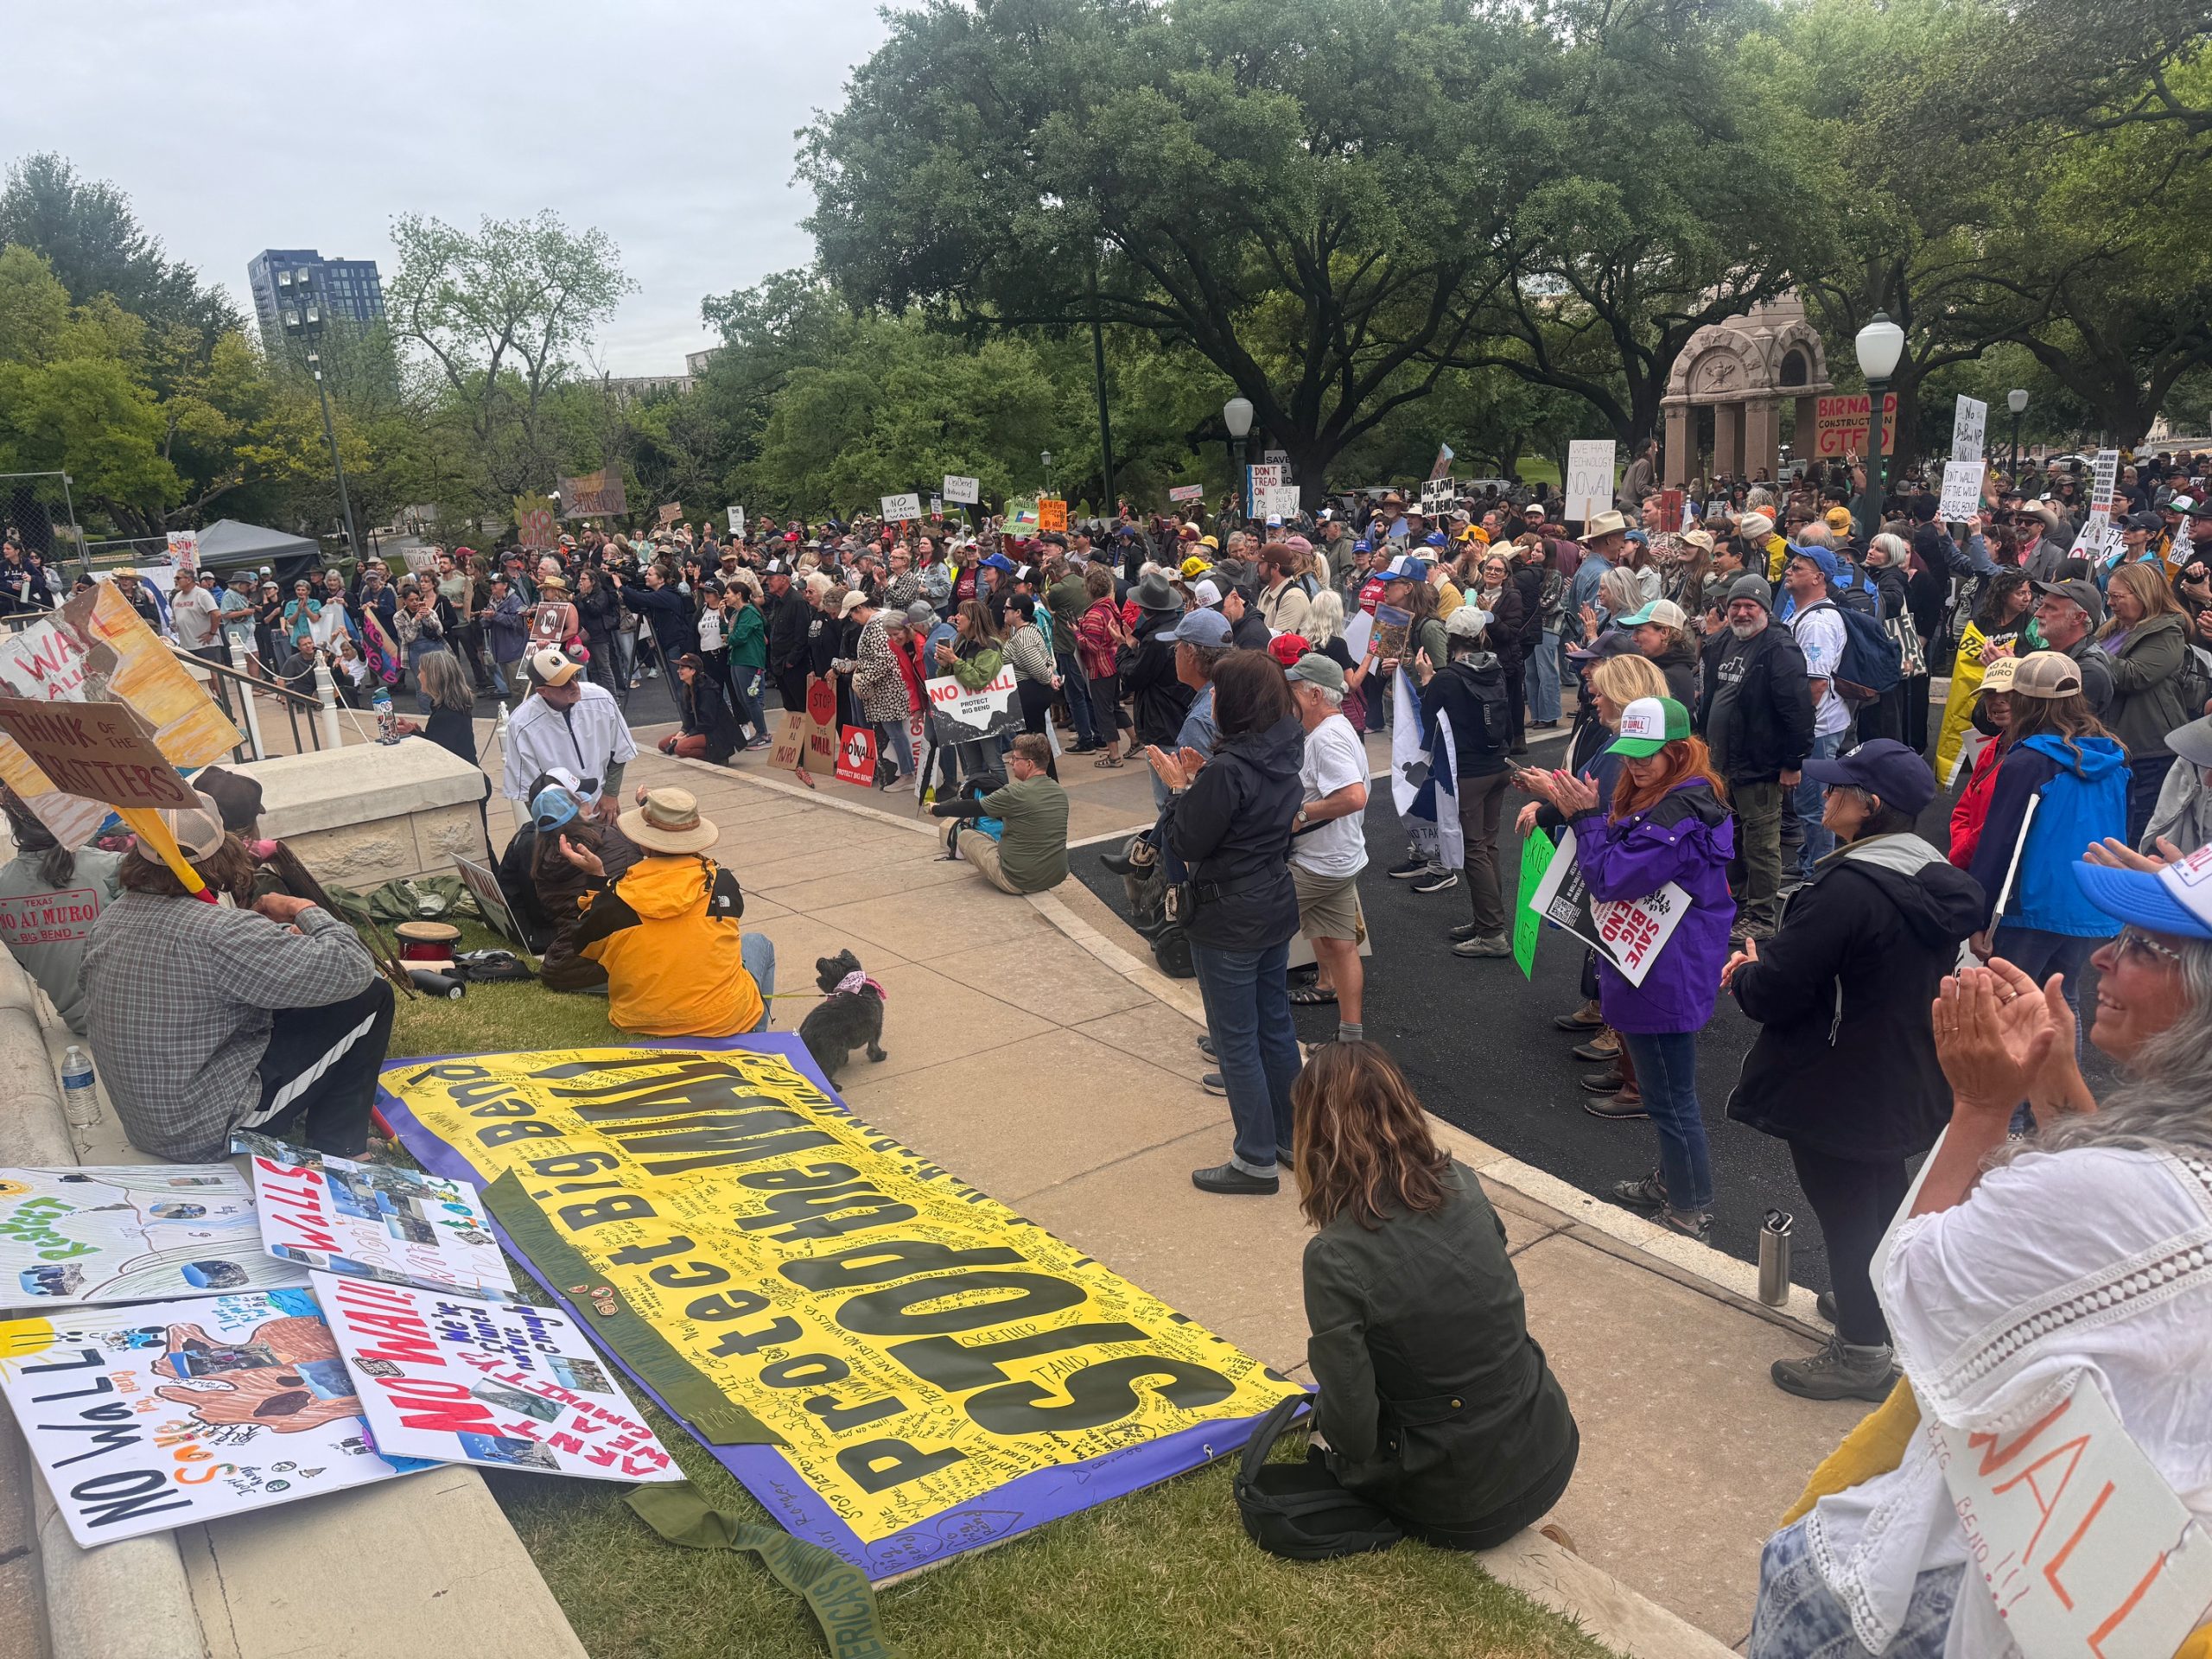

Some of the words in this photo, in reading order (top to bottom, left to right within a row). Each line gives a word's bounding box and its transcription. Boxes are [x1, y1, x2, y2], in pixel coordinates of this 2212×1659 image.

[1819, 396, 1897, 416] BARNAD
[1819, 416, 1892, 429] CONSTRUCTN
[1572, 444, 1588, 454] WE
[1592, 442, 1615, 454] HAVE
[1266, 455, 1291, 464] SAVE
[1570, 456, 1612, 467] TECHNOLOGY
[1253, 477, 1277, 486] TREAD
[1567, 471, 1584, 495] NO
[1585, 474, 1611, 496] WALL
[1960, 471, 1974, 483] WALL
[1254, 487, 1265, 496] ON
[1422, 483, 1434, 496] BIG
[1436, 479, 1453, 492] LOVE
[1942, 485, 1952, 496] OFF
[1953, 486, 1961, 497] THE
[1962, 486, 1977, 497] WILD
[890, 497, 906, 507] NO
[1422, 504, 1434, 516] BIG
[1436, 500, 1453, 513] BEND
[1961, 502, 1976, 512] BEND
[522, 511, 552, 529] NO
[176, 540, 192, 550] STOP
[520, 530, 557, 547] WALL
[813, 692, 832, 709] STOP
[930, 684, 959, 703] NO
[960, 697, 988, 708] PROTECT
[0, 709, 97, 748] THINK
[97, 721, 118, 734] OF
[790, 716, 802, 730] NO
[1628, 720, 1644, 729] WALL
[104, 736, 139, 748] THE
[789, 732, 796, 741] AL
[811, 735, 832, 756] WALL
[775, 746, 798, 764] MURO
[854, 744, 874, 760] WALL
[33, 750, 185, 802] CRITTERS
[836, 768, 854, 778] PROTECT
[861, 772, 873, 782] BEND
[24, 897, 54, 907] TEXAS
[21, 911, 40, 929] AL
[43, 904, 95, 927] MURO
[1602, 899, 1633, 942] END
[20, 931, 37, 943] BIG
[38, 928, 73, 940] BEND
[1619, 908, 1647, 945] BIG
[1624, 918, 1660, 970] SAVE
[407, 1065, 568, 1148] Bend
[524, 1054, 826, 1176] WALL
[531, 1151, 658, 1231] Big
[707, 1205, 726, 1215] NO
[728, 1203, 753, 1217] BAD
[733, 1162, 917, 1243] the
[743, 1199, 766, 1214] IDEA
[632, 1275, 652, 1292] BARTON
[873, 1280, 903, 1290] CLEAR
[906, 1273, 933, 1281] RIVER
[615, 1287, 636, 1302] WILD!
[627, 1287, 660, 1310] WALL!!
[503, 1306, 563, 1354] enough
[812, 1315, 846, 1338] WALLS
[781, 1242, 1236, 1433] STOP
[843, 1336, 860, 1346] NO
[487, 1325, 536, 1370] nature
[357, 1358, 380, 1375] SAVE
[606, 1235, 969, 1494] Protect
[855, 1345, 894, 1371] NEEDS
[1030, 1356, 1088, 1383] TAND
[109, 1370, 141, 1394] Bend
[889, 1371, 940, 1405] TERLINGUA
[131, 1393, 162, 1414] Big
[374, 1374, 504, 1437] NO
[572, 1415, 605, 1433] A
[1040, 1427, 1071, 1447] Bend
[1077, 1438, 1103, 1454] Jess
[607, 1434, 670, 1467] WE
[961, 1446, 998, 1465] RUIN
[1013, 1441, 1041, 1453] WALL
[1071, 1444, 1092, 1460] Big
[779, 1442, 839, 1492] DESTROYING
[1044, 1454, 1061, 1465] NO
[71, 1470, 191, 1527] NO
[770, 1478, 816, 1528] Ranger
[890, 1487, 913, 1508] HOME
[822, 1495, 863, 1519] STOP
[900, 1508, 924, 1519] MY
[880, 1506, 908, 1529] SAVE
[899, 1536, 928, 1561] Bend
[879, 1545, 907, 1573] Big
